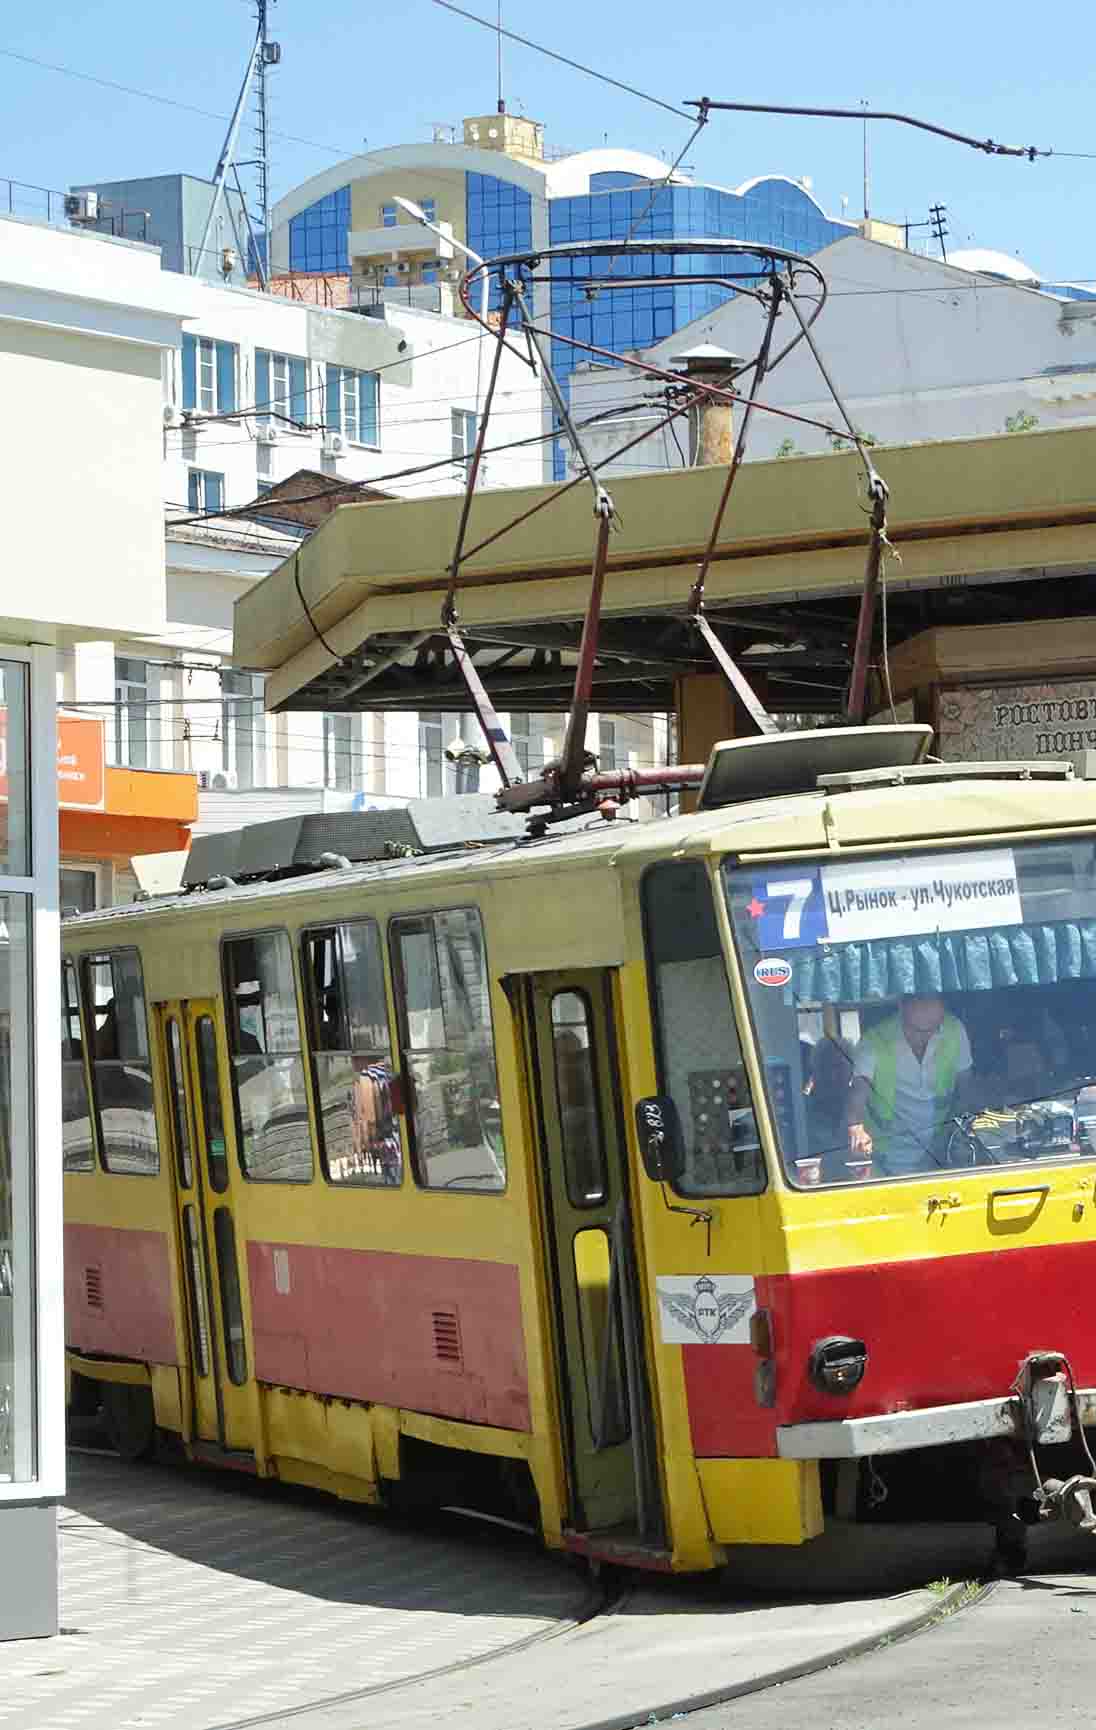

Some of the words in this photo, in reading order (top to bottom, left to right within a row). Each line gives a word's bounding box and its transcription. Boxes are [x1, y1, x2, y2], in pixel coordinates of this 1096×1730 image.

[766, 879, 813, 939] 7
[828, 887, 897, 918] Ц.Рынок
[911, 878, 1016, 911] ул.Чукотская
